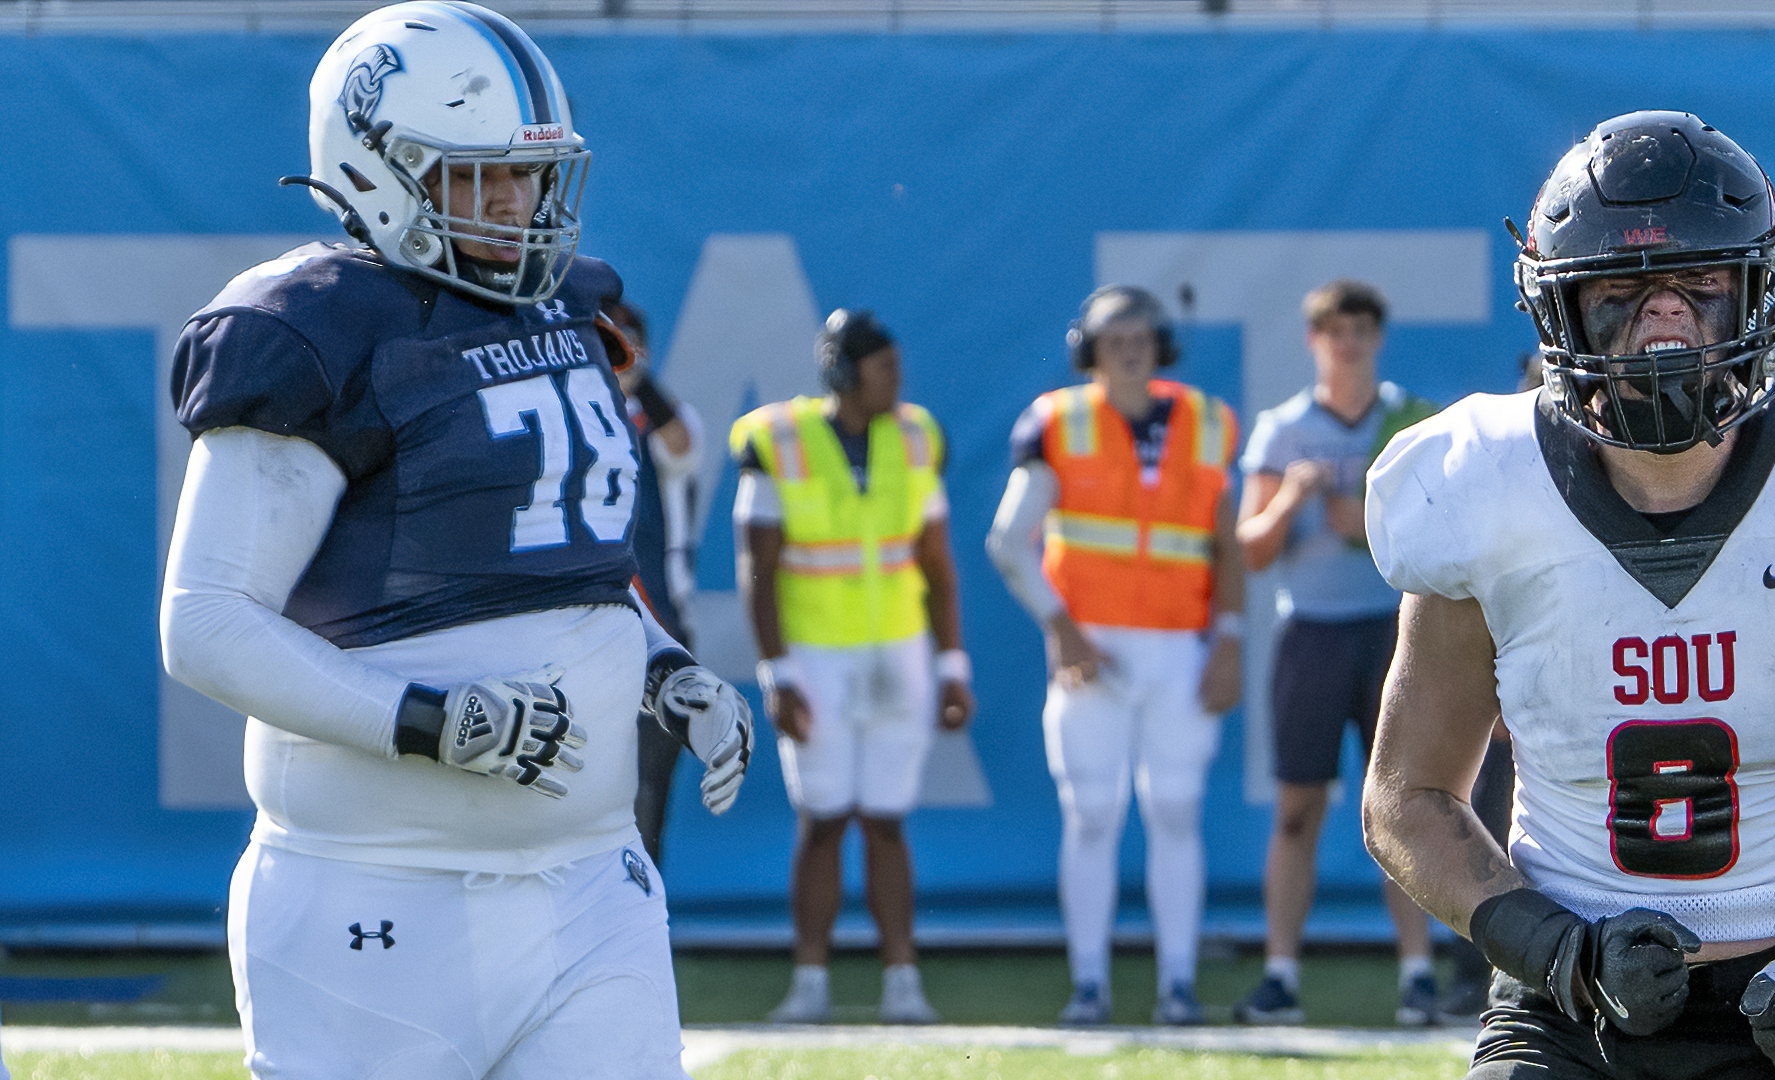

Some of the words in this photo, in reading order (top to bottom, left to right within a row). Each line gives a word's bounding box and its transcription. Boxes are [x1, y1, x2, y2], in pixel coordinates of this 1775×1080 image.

[462, 328, 588, 382] TROJANS
[476, 364, 640, 553] 78
[1612, 630, 1737, 706] SOU
[1606, 716, 1741, 880] 8
